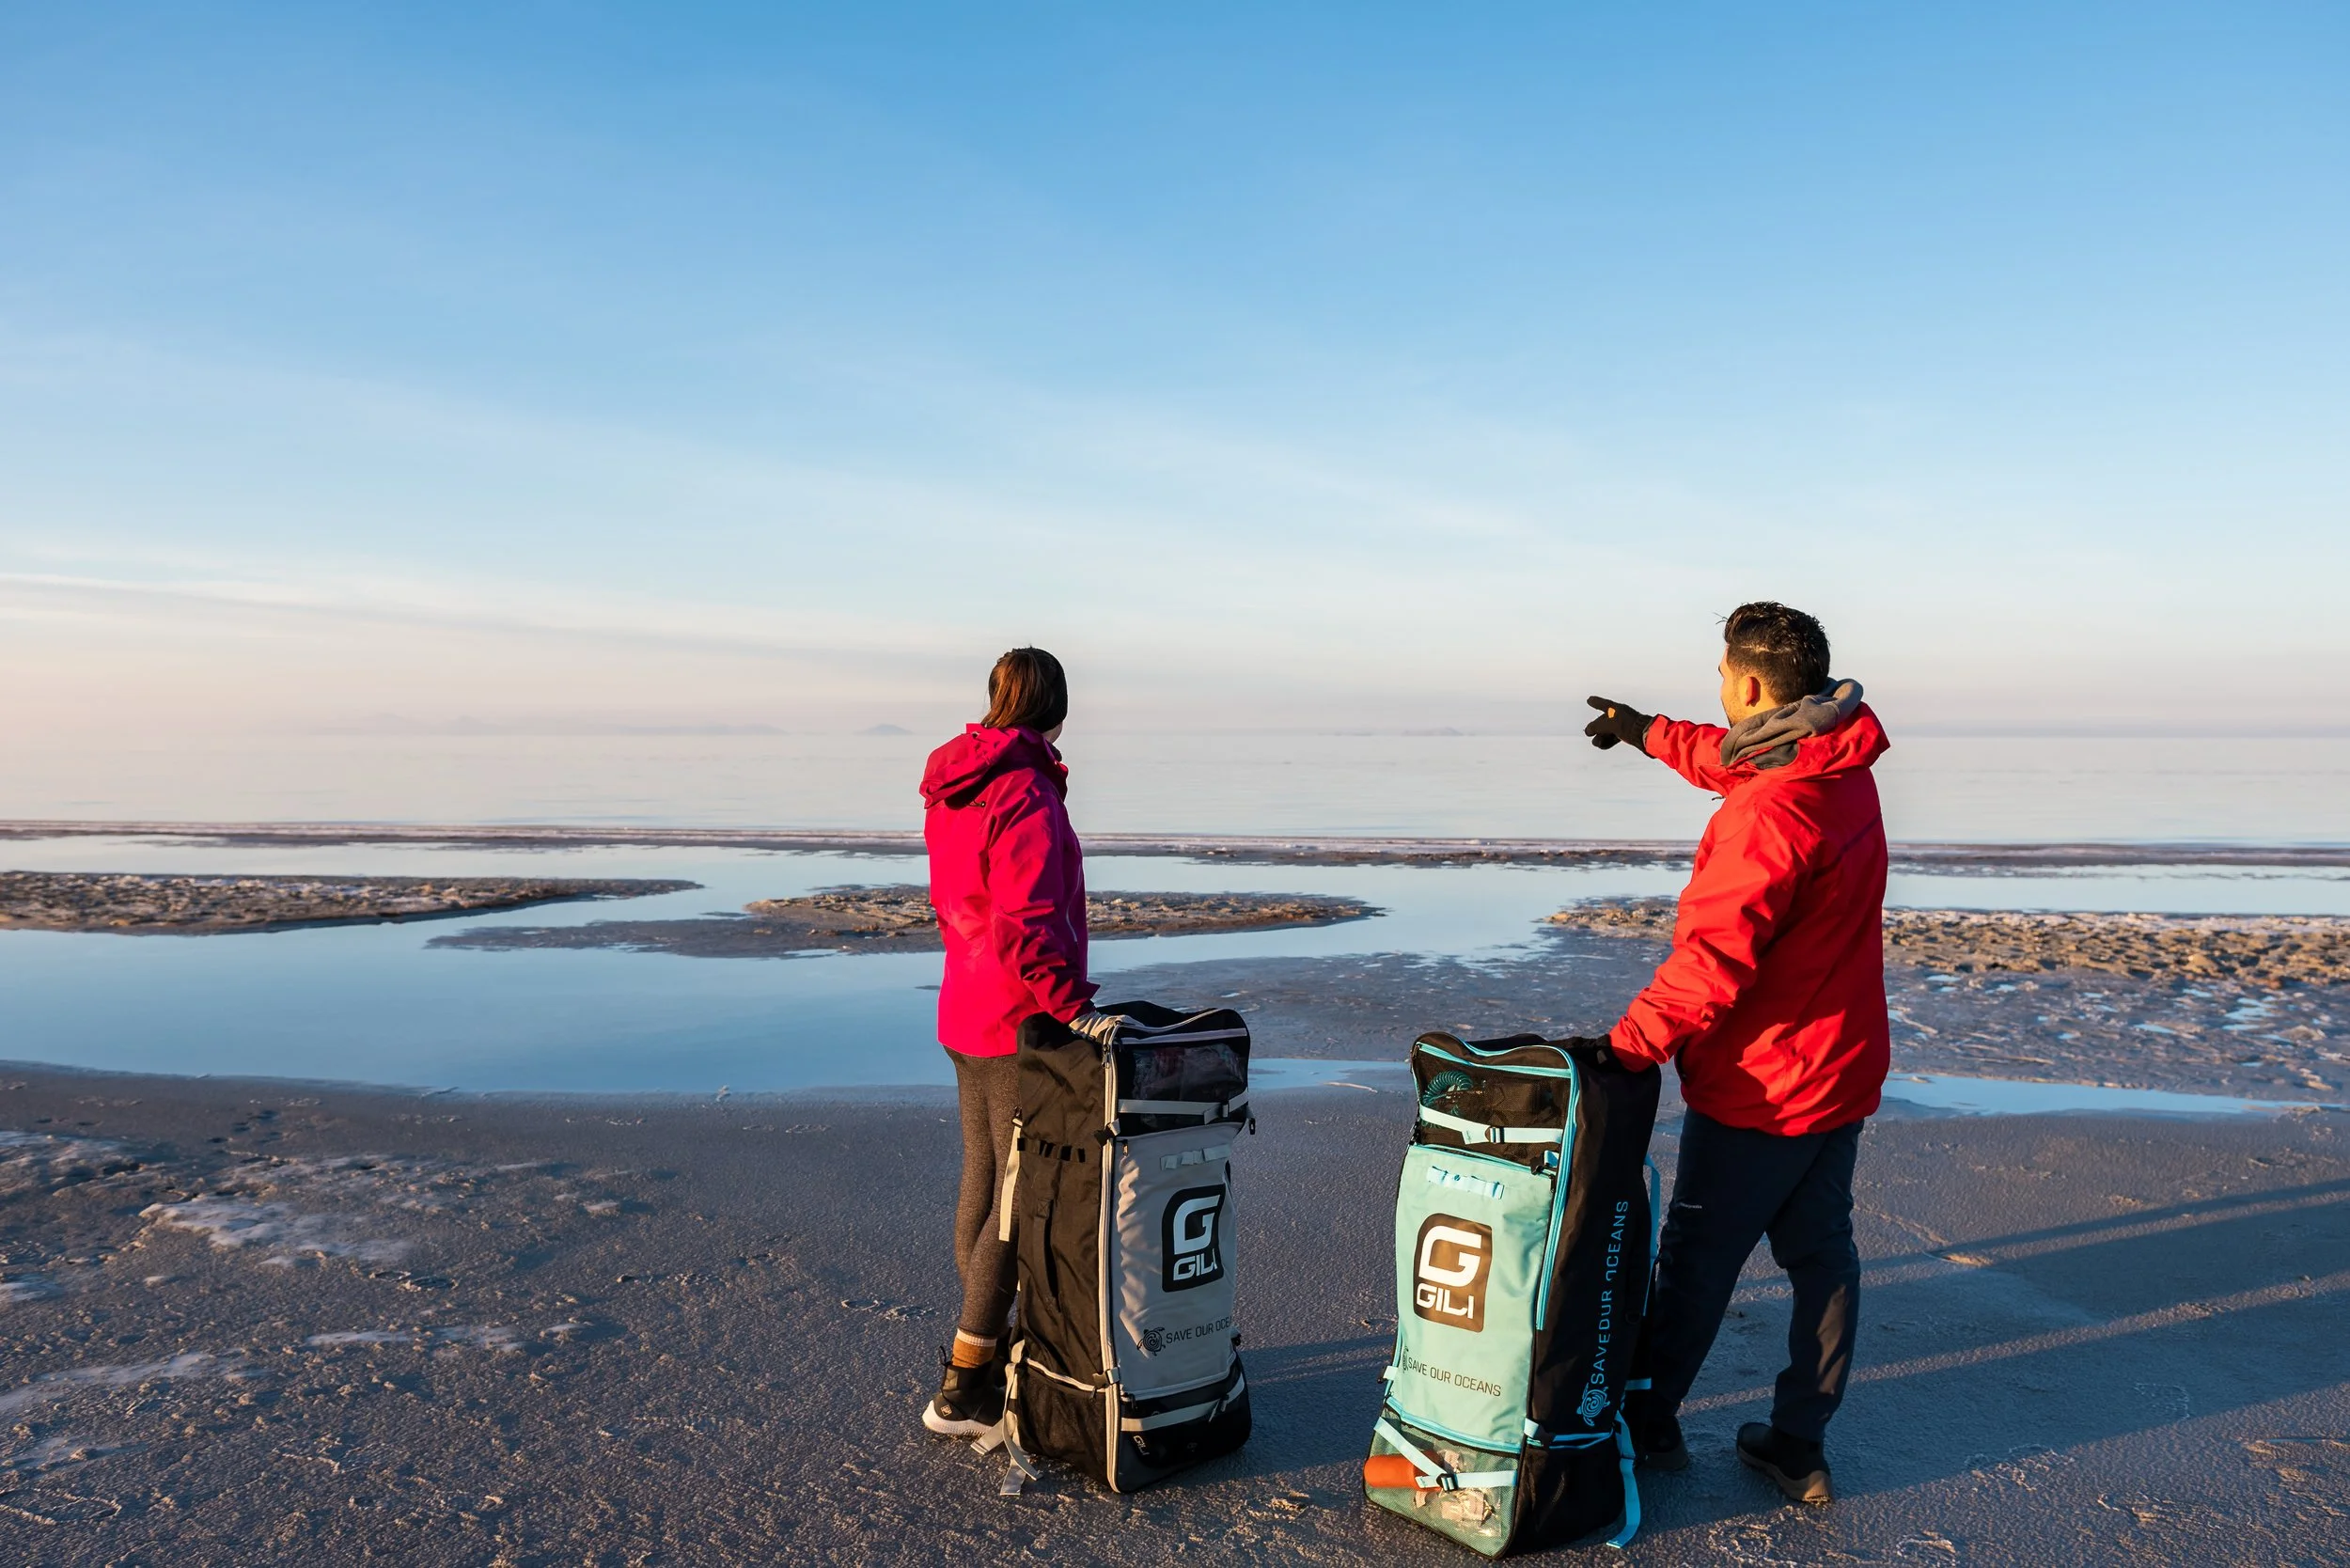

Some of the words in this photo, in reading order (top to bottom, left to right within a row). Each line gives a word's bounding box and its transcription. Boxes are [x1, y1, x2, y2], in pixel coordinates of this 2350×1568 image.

[1173, 1194, 1220, 1255] G
[1173, 1247, 1218, 1280] GILI
[1418, 1225, 1481, 1287] G
[1416, 1282, 1474, 1319] GILI
[1166, 1328, 1193, 1344] SAVE
[1195, 1323, 1214, 1338] OUR
[1408, 1356, 1427, 1376] SAVE
[1430, 1367, 1451, 1384] OUR
[1454, 1373, 1501, 1397] OCEANS
[1590, 1334, 1610, 1384] SAVE
